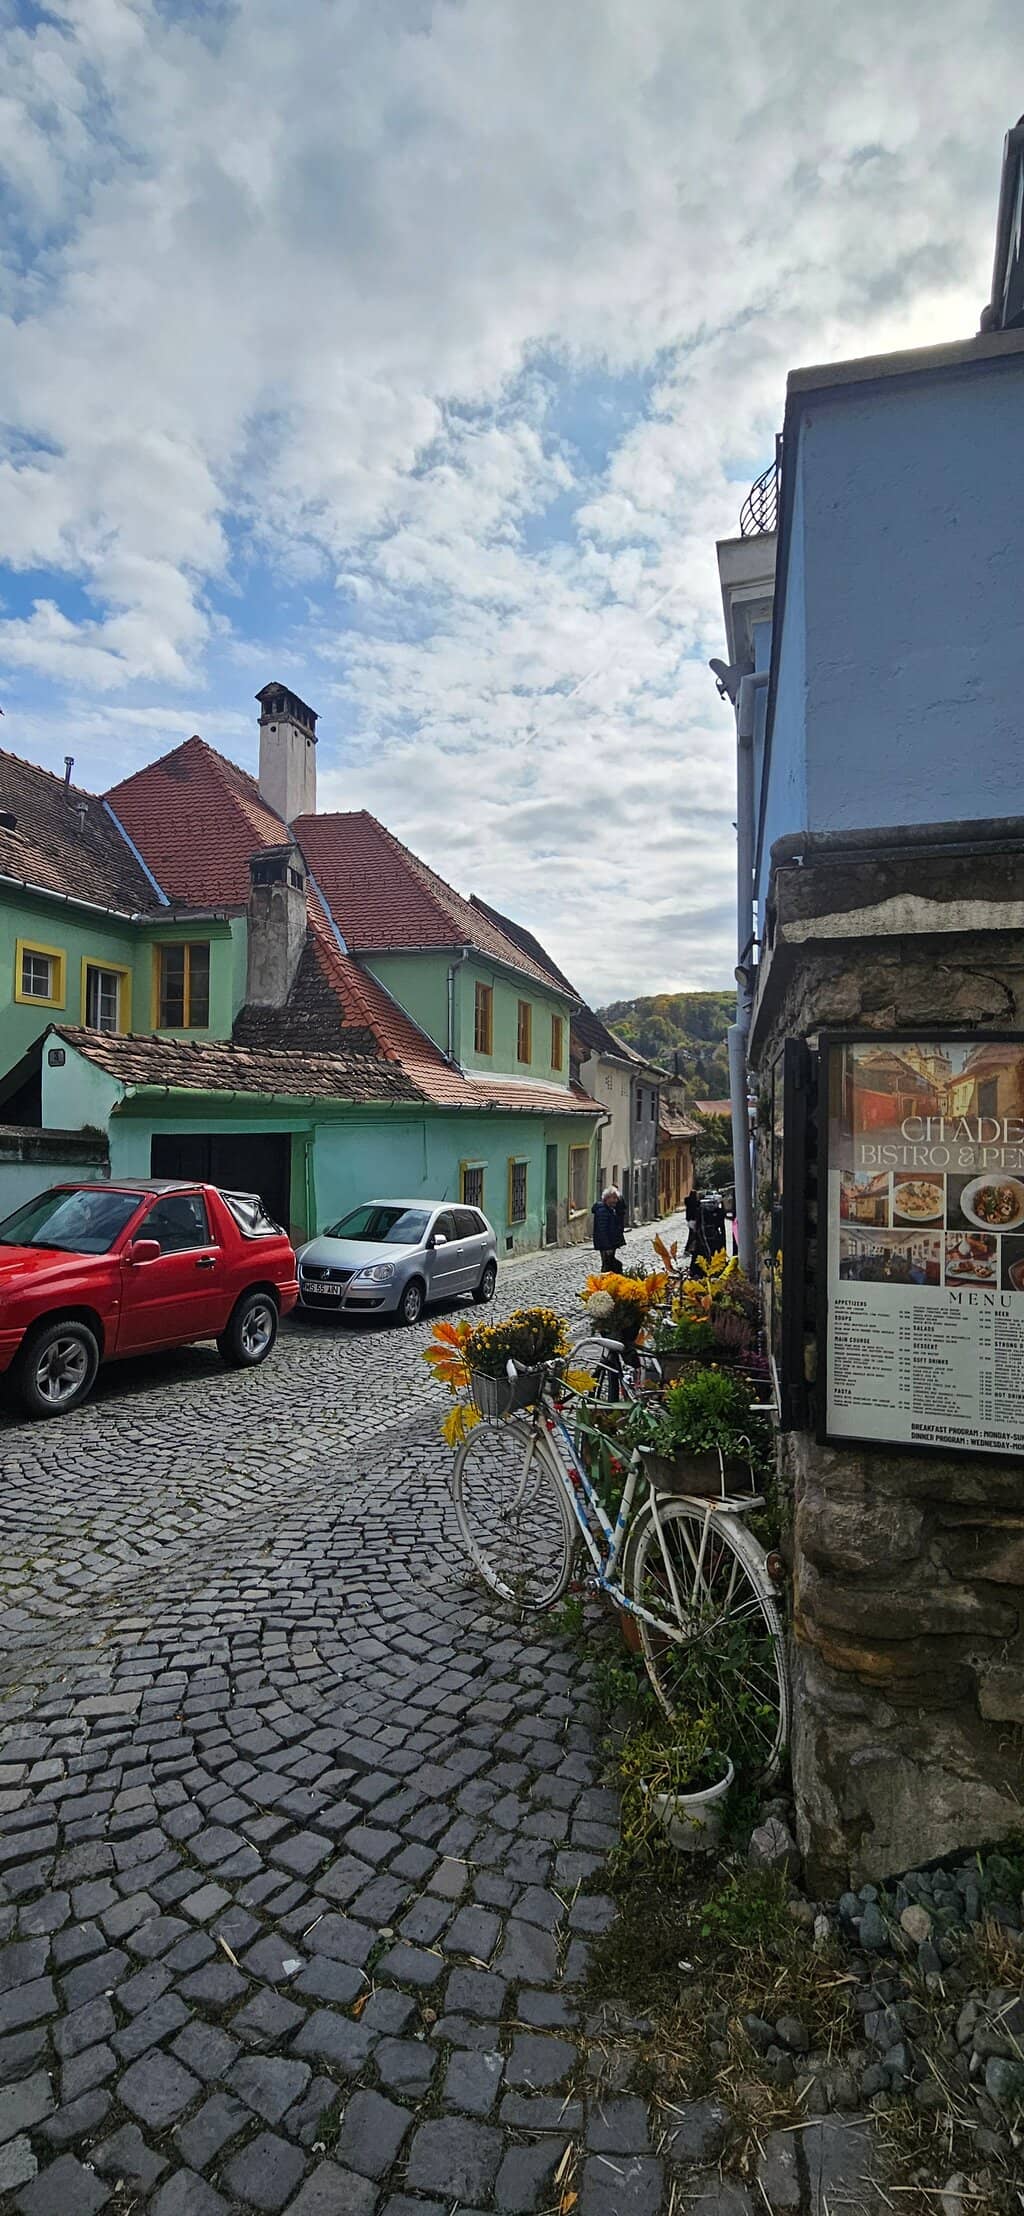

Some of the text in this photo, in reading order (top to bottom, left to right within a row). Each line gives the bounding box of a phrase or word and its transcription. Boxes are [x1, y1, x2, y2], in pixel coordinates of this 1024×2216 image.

[901, 1116, 1024, 1144] CITADE
[861, 1144, 950, 1166] BISTRO
[958, 1146, 975, 1168] &
[834, 1299, 867, 1307] APPETIZERS
[949, 1291, 1012, 1308] MENU
[994, 1341, 1018, 1349] STRONG
[911, 1423, 947, 1434] BREAKFAST
[948, 1427, 979, 1437] PROGRAM
[911, 1432, 934, 1440] DINNER
[935, 1435, 965, 1445] PROGRAM
